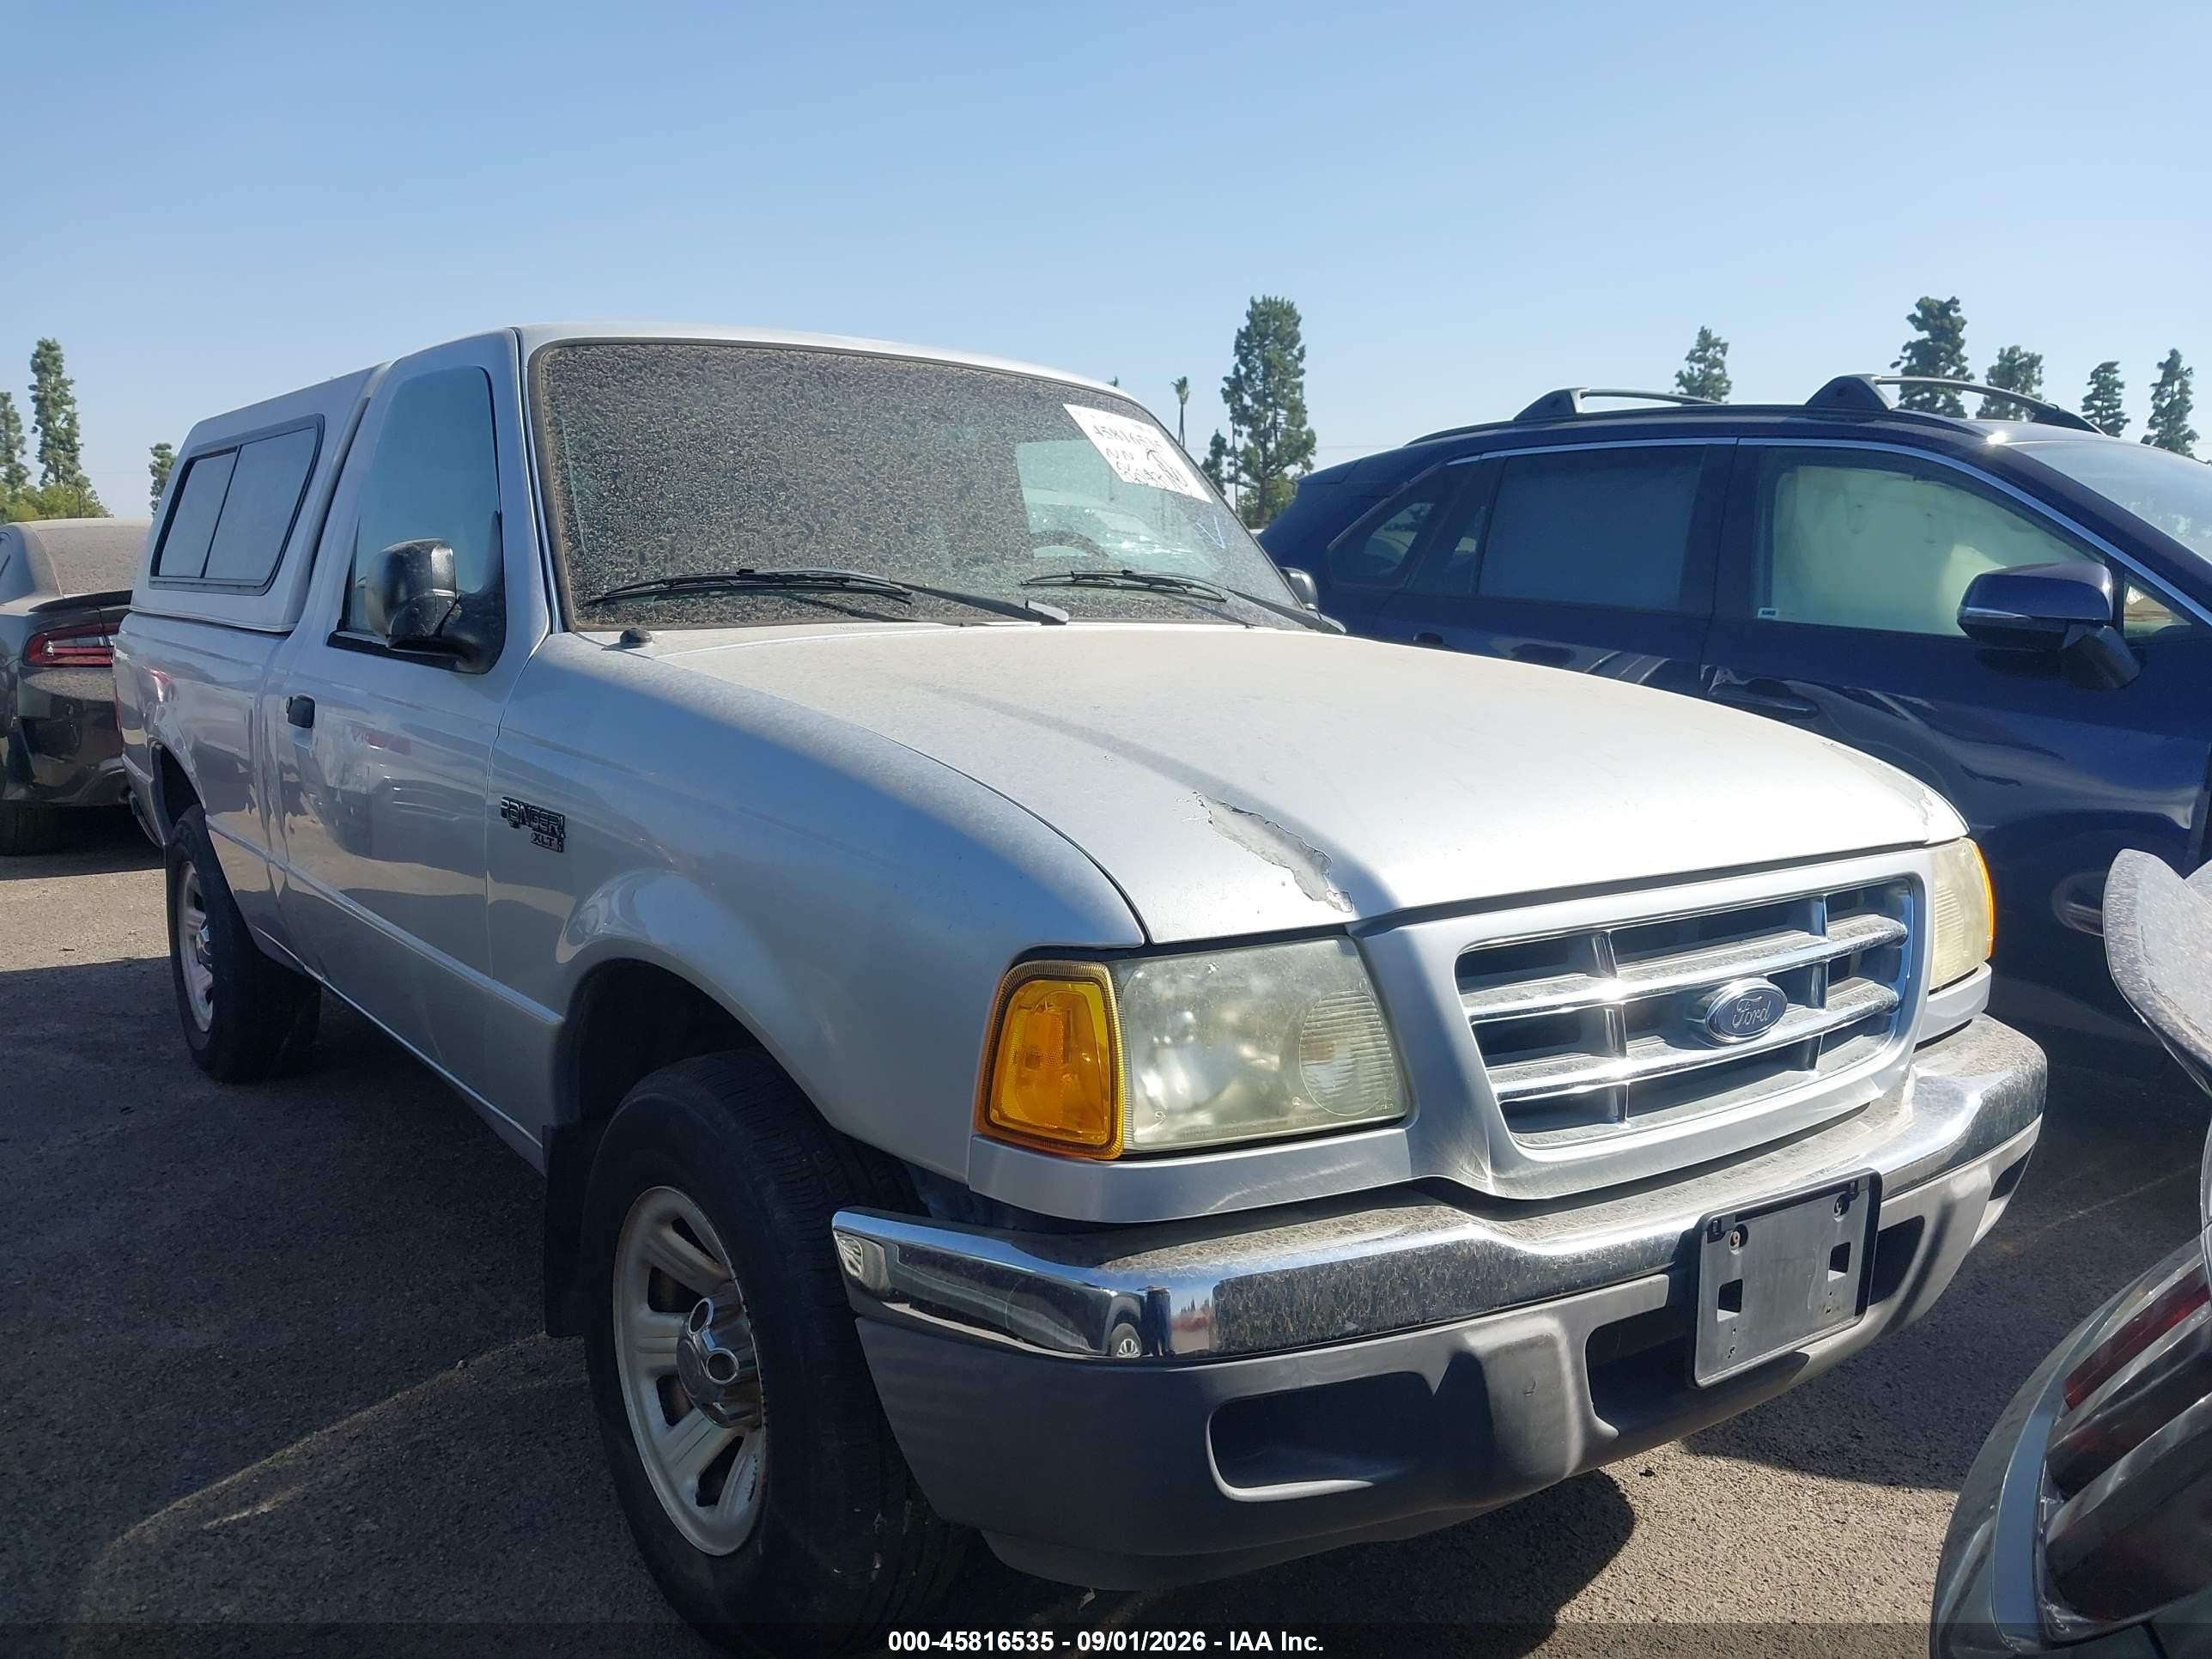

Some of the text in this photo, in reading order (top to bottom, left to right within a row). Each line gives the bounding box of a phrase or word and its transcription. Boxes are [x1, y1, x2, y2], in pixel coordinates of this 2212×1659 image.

[501, 797, 564, 838] RANGER
[532, 832, 556, 848] XLT
[1732, 996, 1771, 1029] Ford
